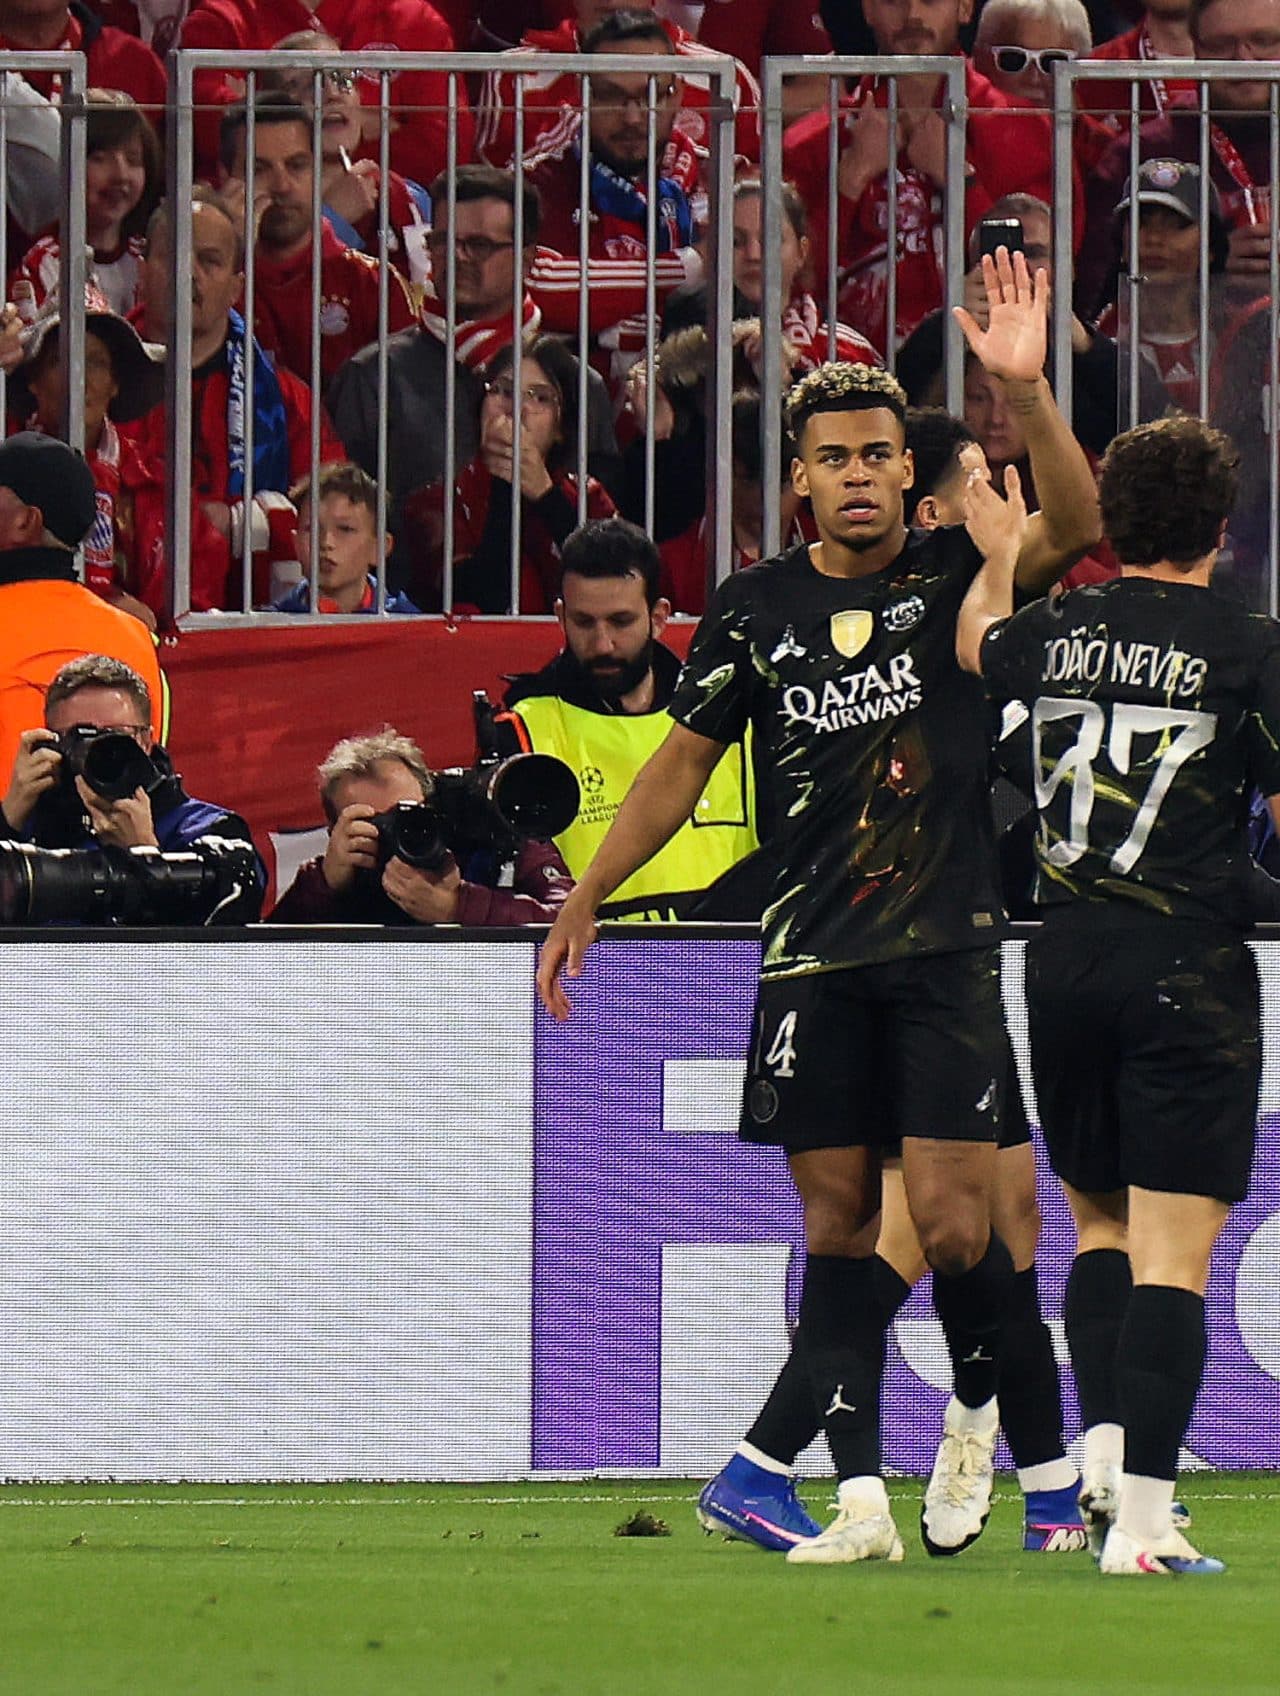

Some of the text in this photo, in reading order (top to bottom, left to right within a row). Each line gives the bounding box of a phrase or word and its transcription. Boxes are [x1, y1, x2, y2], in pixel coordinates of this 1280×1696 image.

[783, 653, 921, 725] QATAR
[1042, 626, 1208, 697] JOÃO NEVES
[815, 687, 922, 734] AIRWAYS
